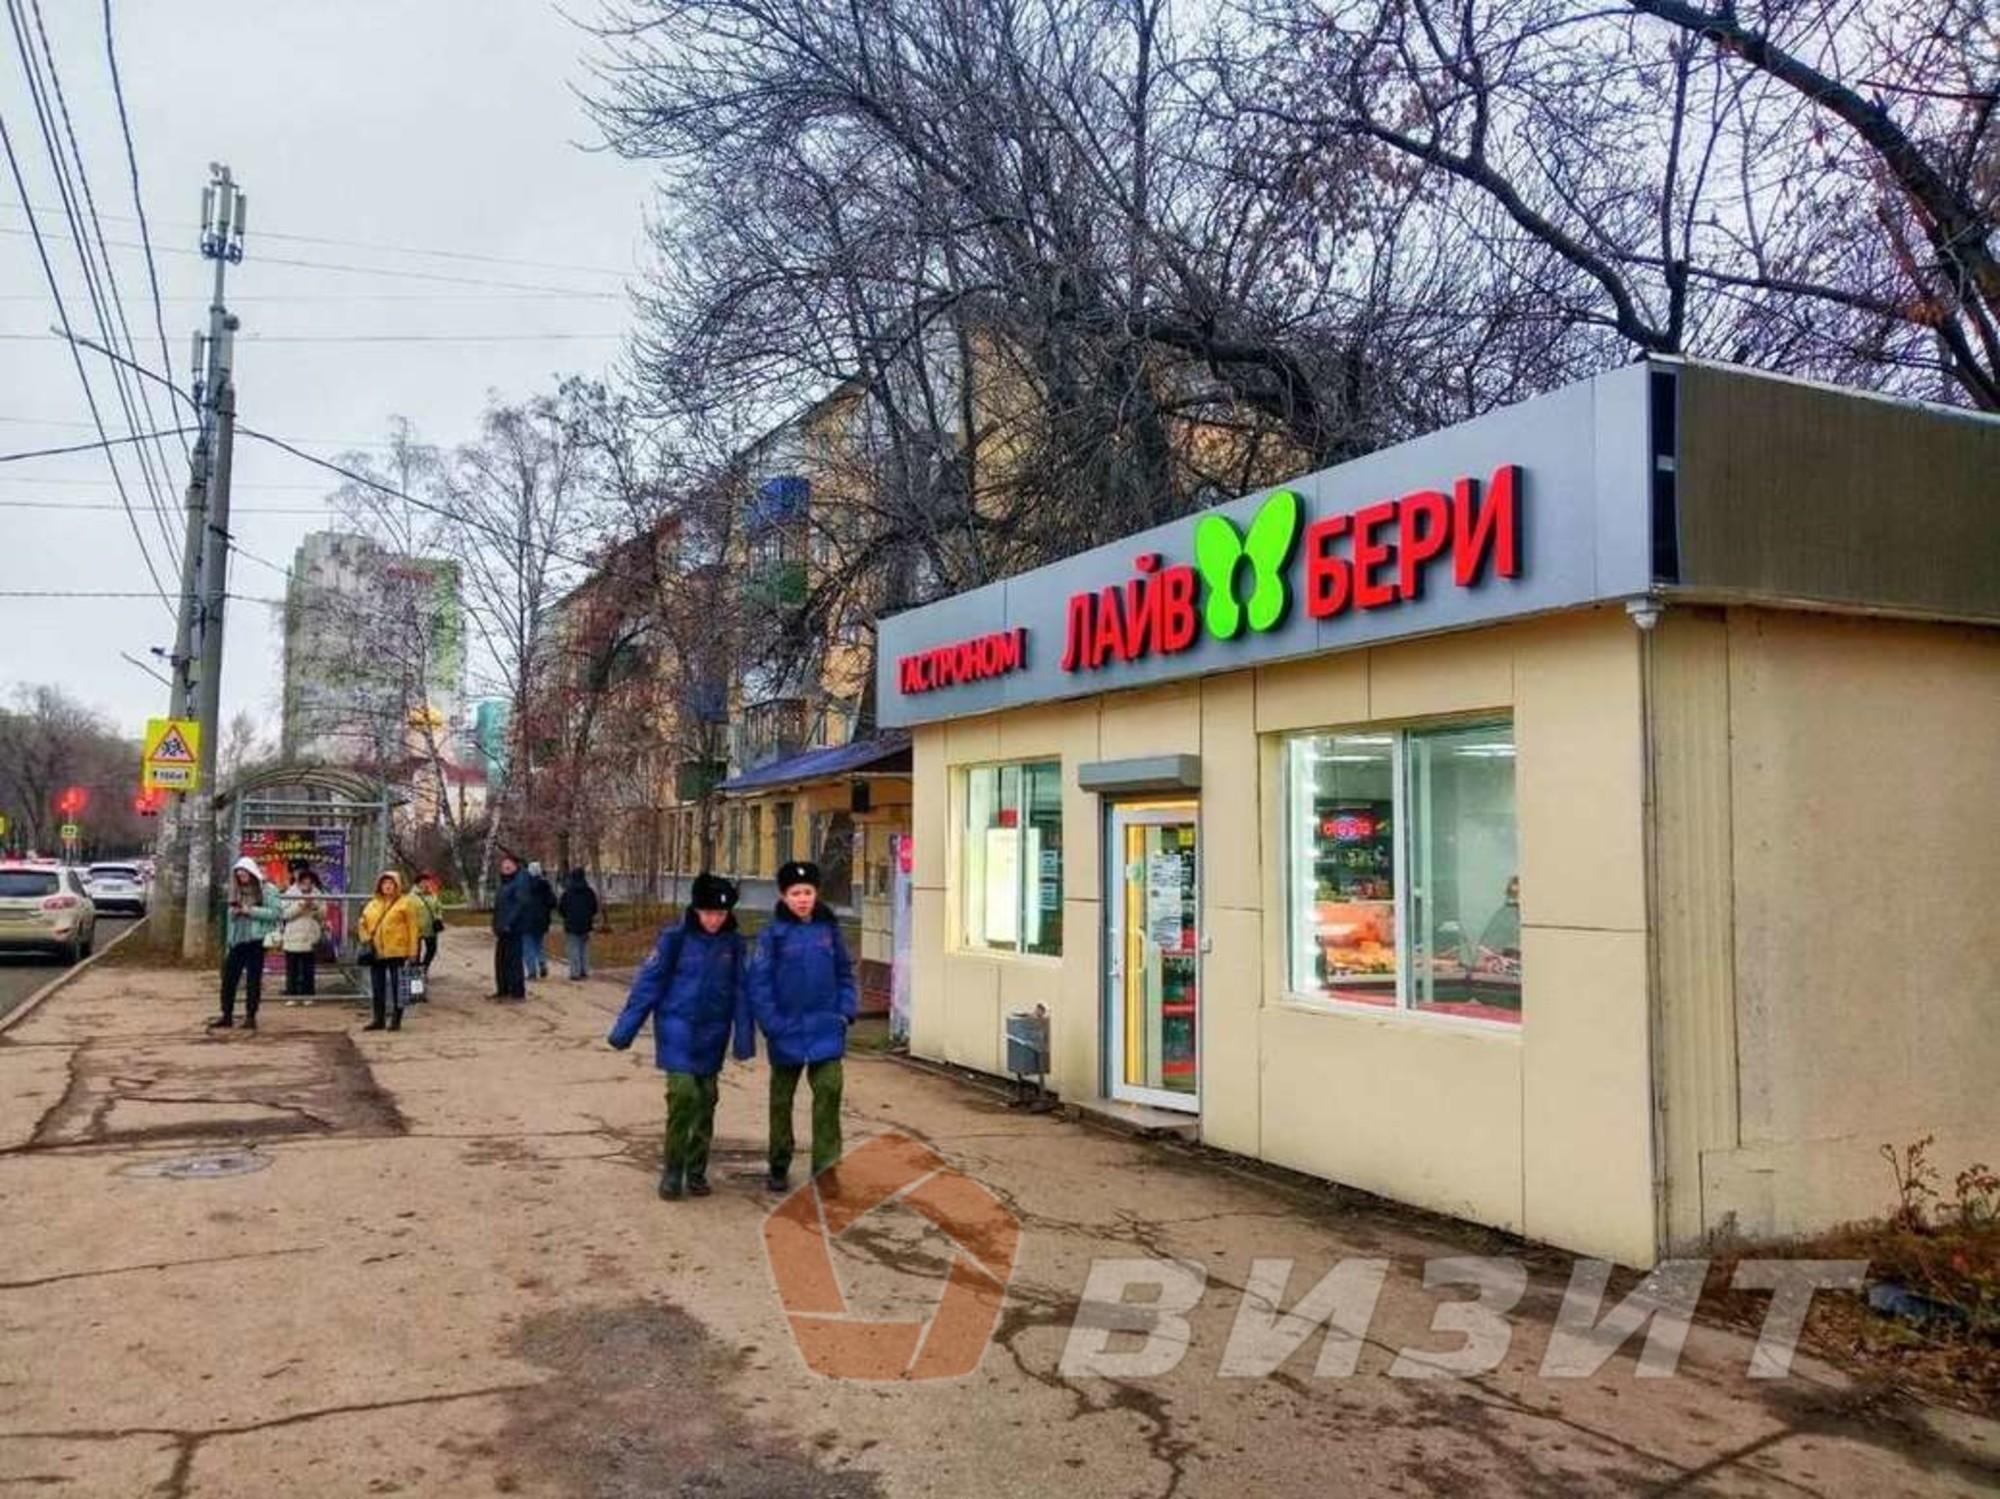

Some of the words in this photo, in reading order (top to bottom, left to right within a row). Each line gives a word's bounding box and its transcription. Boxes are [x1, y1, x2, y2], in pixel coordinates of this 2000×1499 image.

[896, 627, 1028, 695] ГАСТРОНОМ
[1060, 551, 1201, 673] ЛАЙВ
[1305, 464, 1523, 621] БЕРИ
